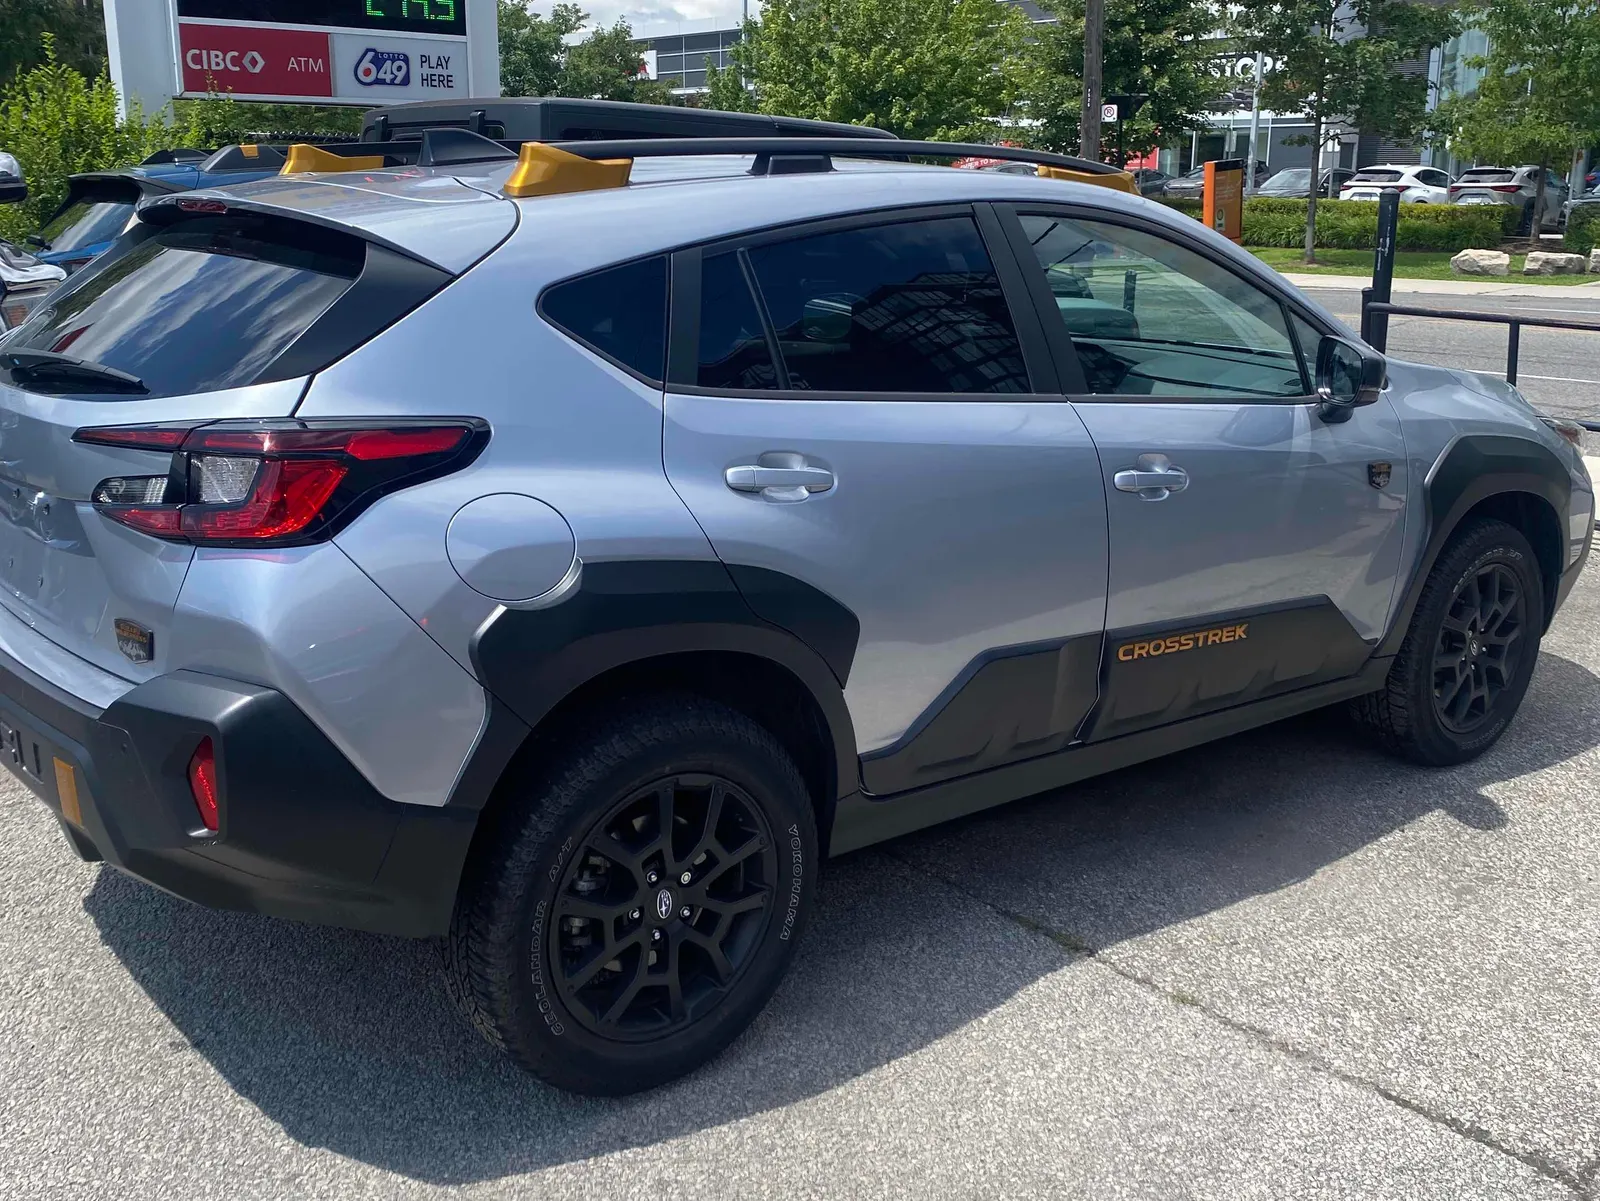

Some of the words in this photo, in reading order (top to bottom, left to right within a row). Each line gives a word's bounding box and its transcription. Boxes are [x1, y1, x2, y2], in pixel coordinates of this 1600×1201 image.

[186, 48, 241, 72] CIBC
[287, 56, 324, 73] ATM
[419, 54, 451, 70] PLAY
[420, 73, 454, 89] HERE
[1117, 623, 1249, 662] CROSSTREK
[780, 824, 803, 940] YOKOHAMA
[531, 900, 564, 1036] GEOLANDAR
